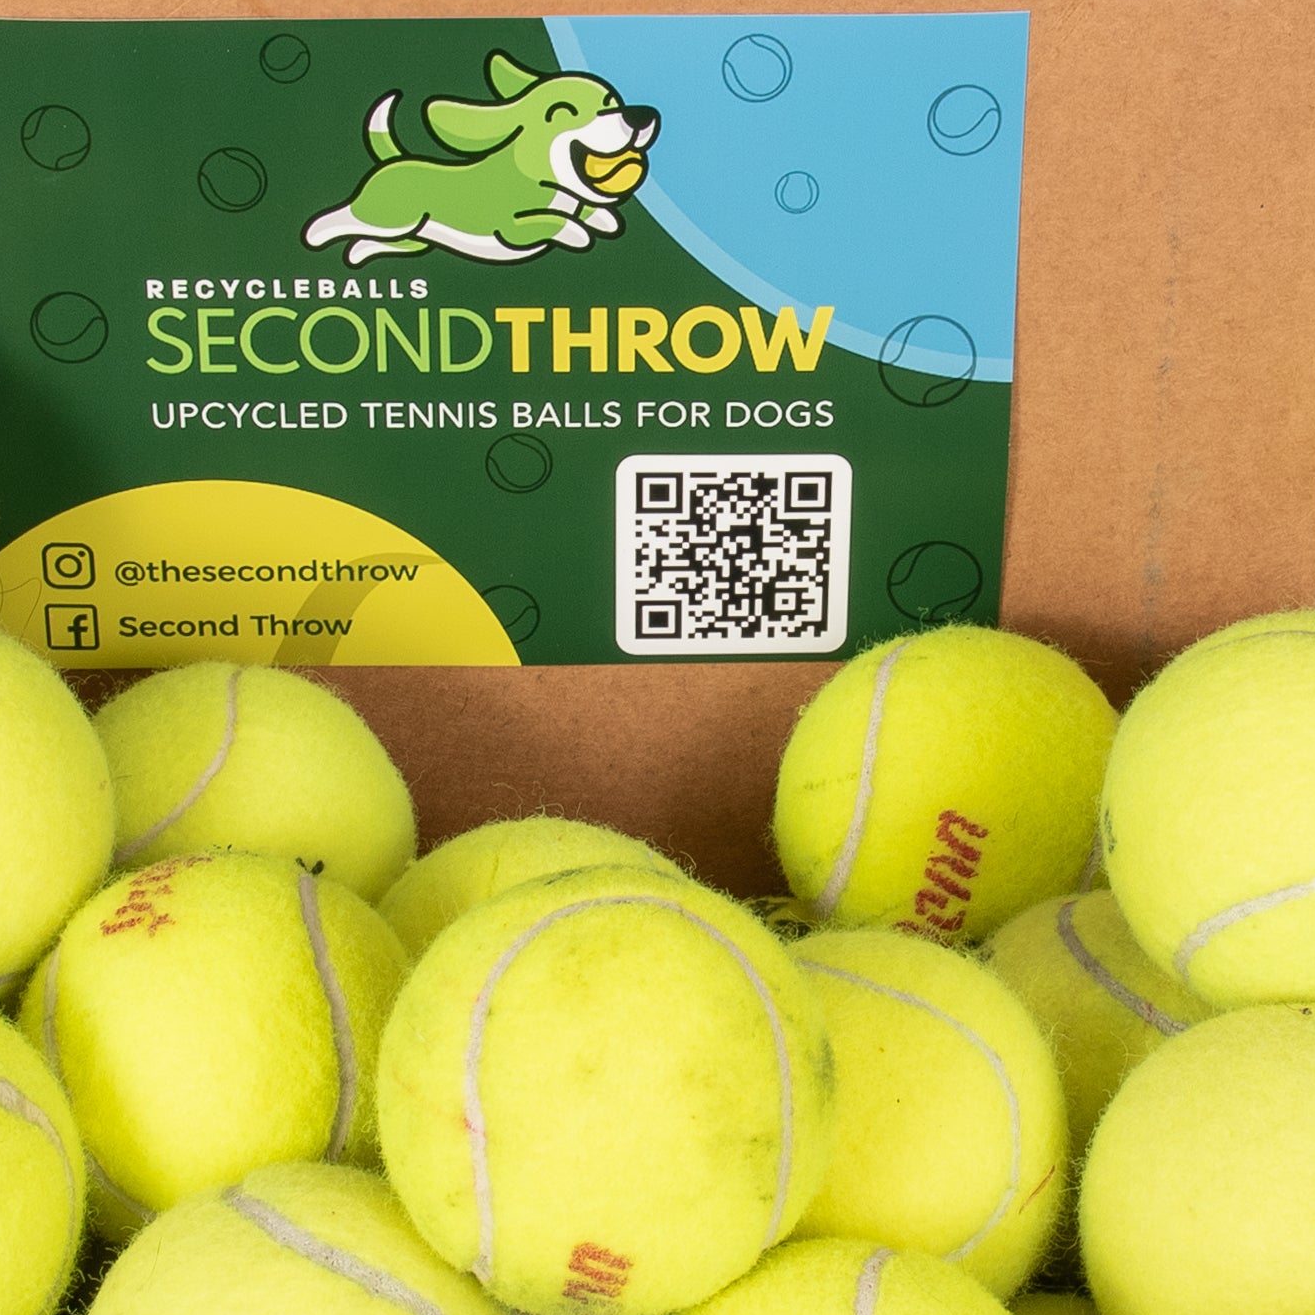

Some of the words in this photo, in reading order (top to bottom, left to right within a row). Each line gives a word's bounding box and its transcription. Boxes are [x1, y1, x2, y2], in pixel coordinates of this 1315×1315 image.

[145, 277, 430, 300] RECYCLEBALLS
[145, 304, 836, 375] SECONDTHROW
[151, 400, 349, 429] UPCYCLED
[359, 400, 499, 429] TENNIS
[512, 400, 622, 429] BALLS
[637, 400, 712, 428] FOR
[725, 399, 836, 428] DOGS
[114, 559, 419, 587] @thesecondthrow
[117, 614, 239, 638] Second
[249, 614, 354, 637] Throw
